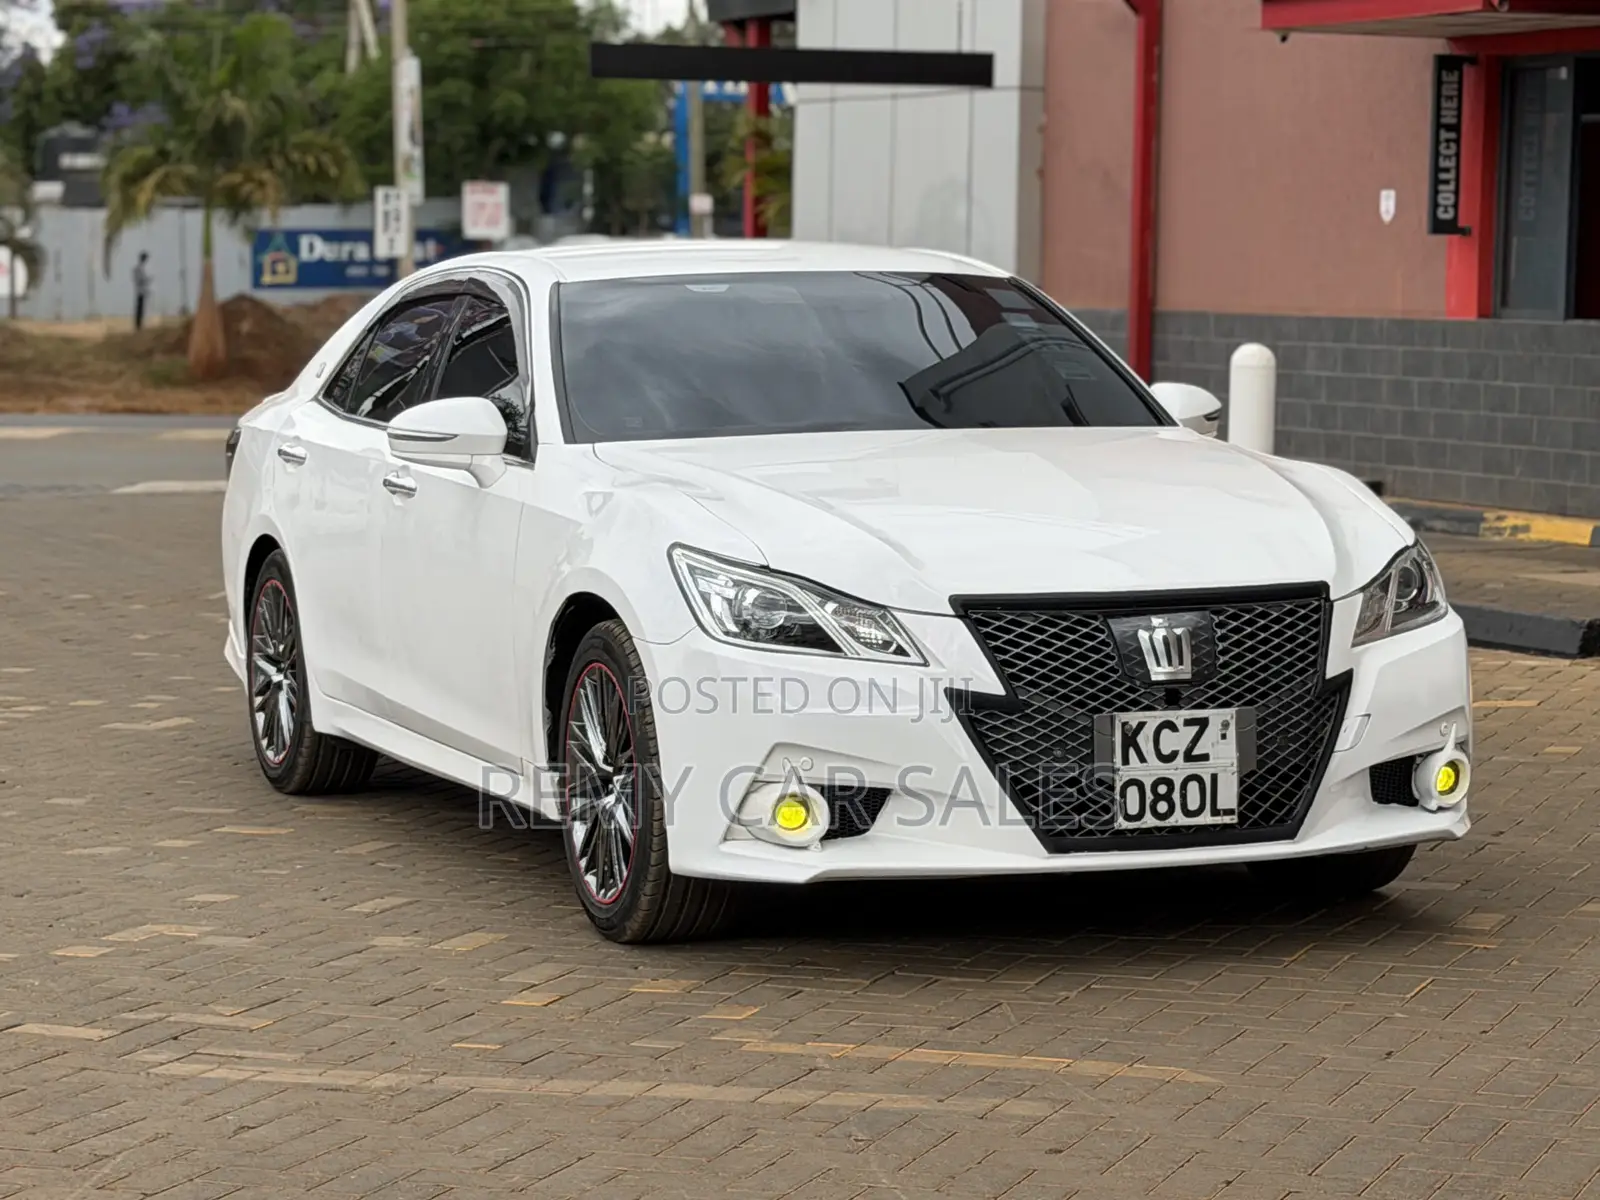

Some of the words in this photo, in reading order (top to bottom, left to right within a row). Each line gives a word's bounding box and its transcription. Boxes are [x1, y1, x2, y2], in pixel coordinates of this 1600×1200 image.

[1440, 70, 1459, 125] HERE
[1436, 129, 1458, 220] COLLECT
[299, 234, 370, 262] Dura
[1120, 716, 1210, 766] KCZ
[1119, 773, 1236, 823] 080L
